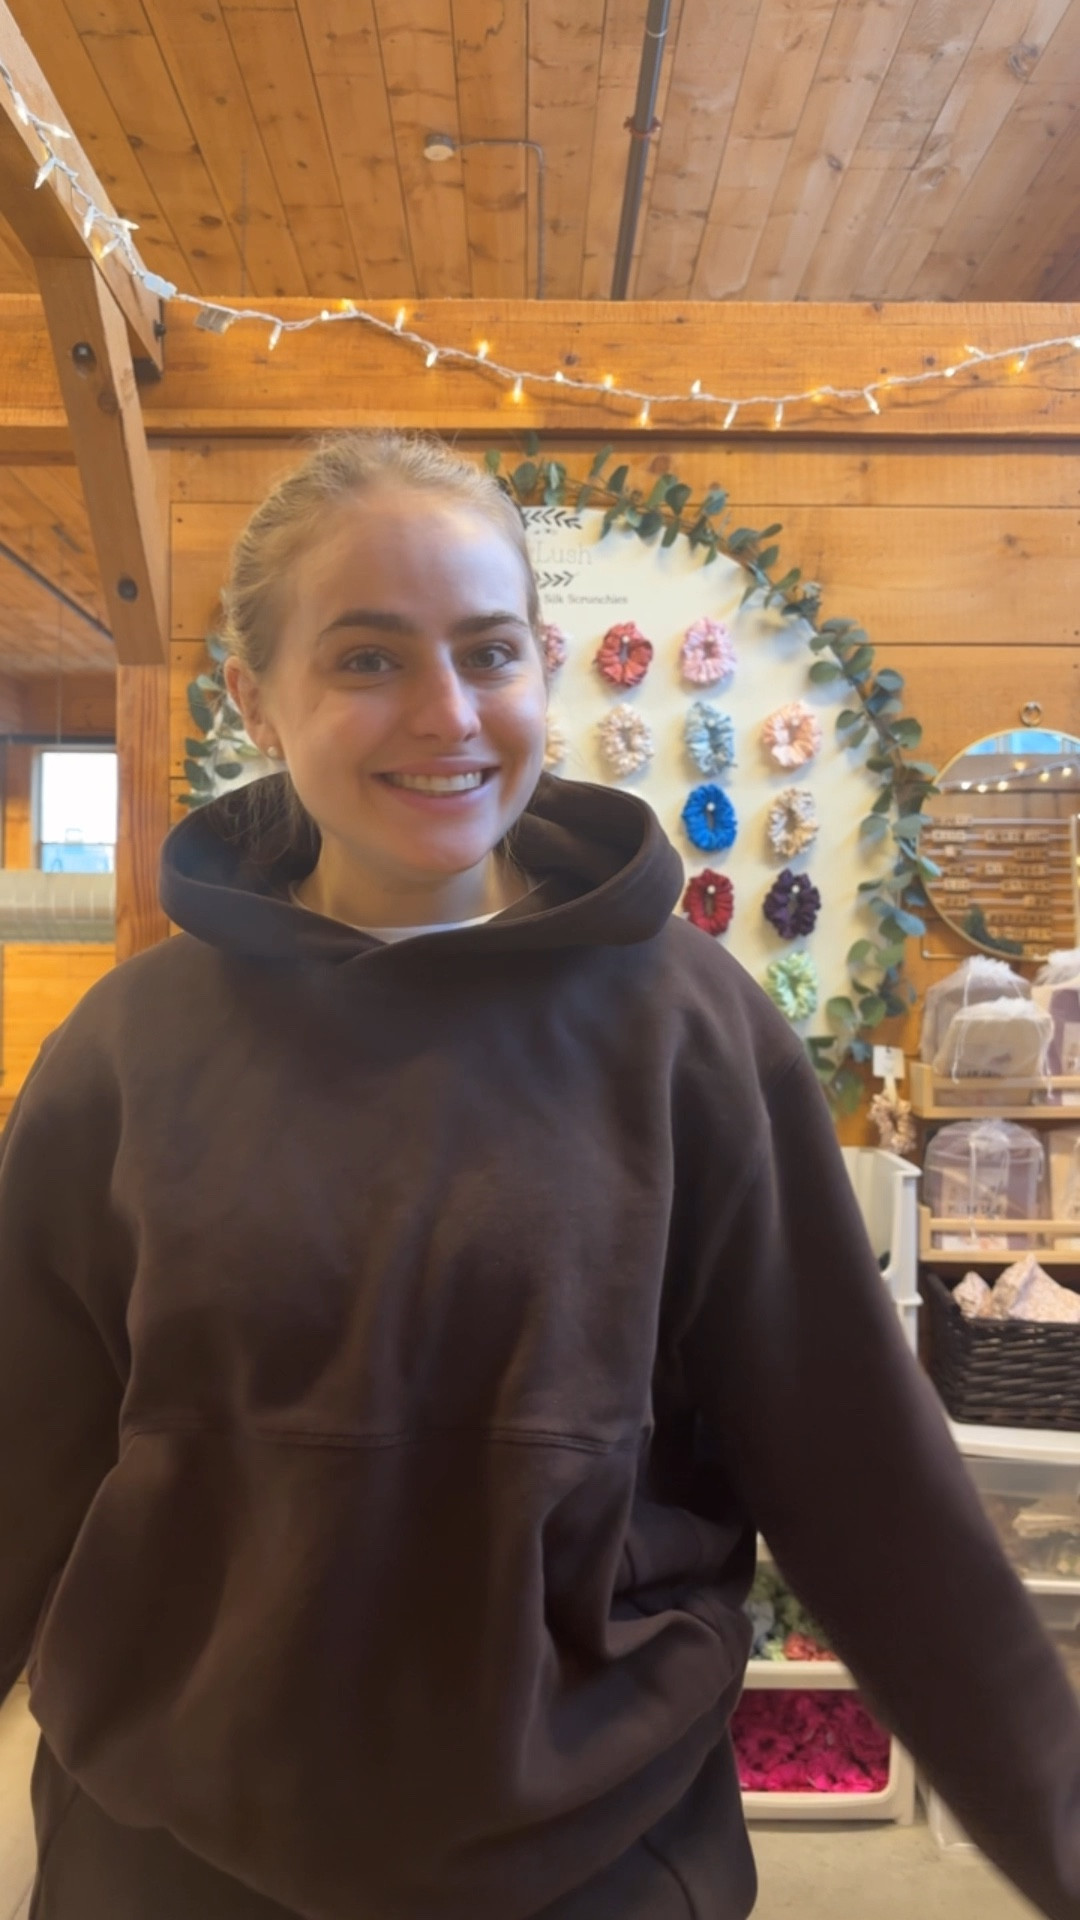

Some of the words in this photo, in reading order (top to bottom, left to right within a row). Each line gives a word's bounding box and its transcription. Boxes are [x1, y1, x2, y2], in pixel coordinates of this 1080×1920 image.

[531, 540, 592, 565] Lush
[544, 593, 563, 604] Silk
[567, 593, 629, 604] Scrunchies
